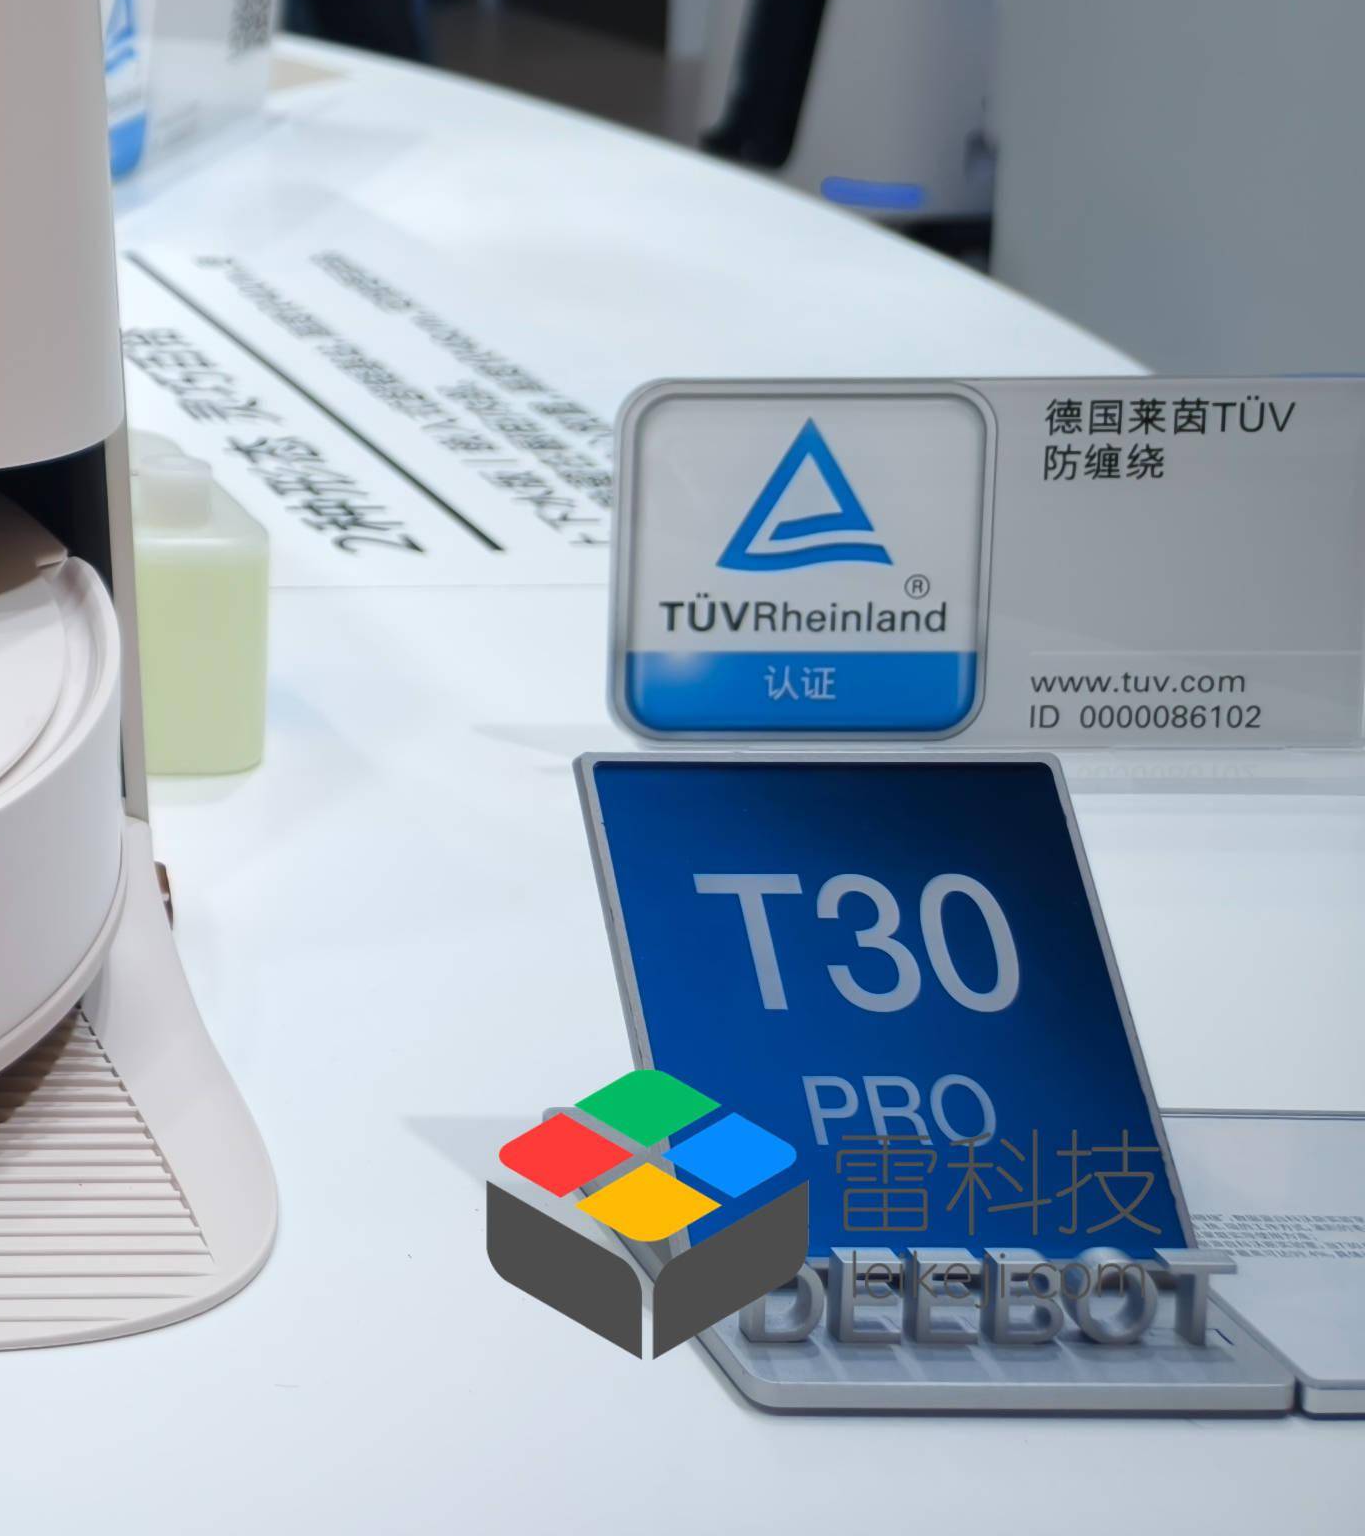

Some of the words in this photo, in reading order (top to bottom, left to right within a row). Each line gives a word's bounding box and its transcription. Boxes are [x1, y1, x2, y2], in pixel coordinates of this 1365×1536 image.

[1044, 394, 1297, 437] 德国莱茵TÜV
[1042, 442, 1165, 482] 防缠绕
[763, 664, 838, 703] 认证
[1030, 672, 1246, 695] www.tuv.com
[1029, 705, 1061, 730] ID
[1079, 705, 1263, 730] 0000086102
[692, 873, 1020, 1013] T30
[801, 1073, 997, 1147] PRO
